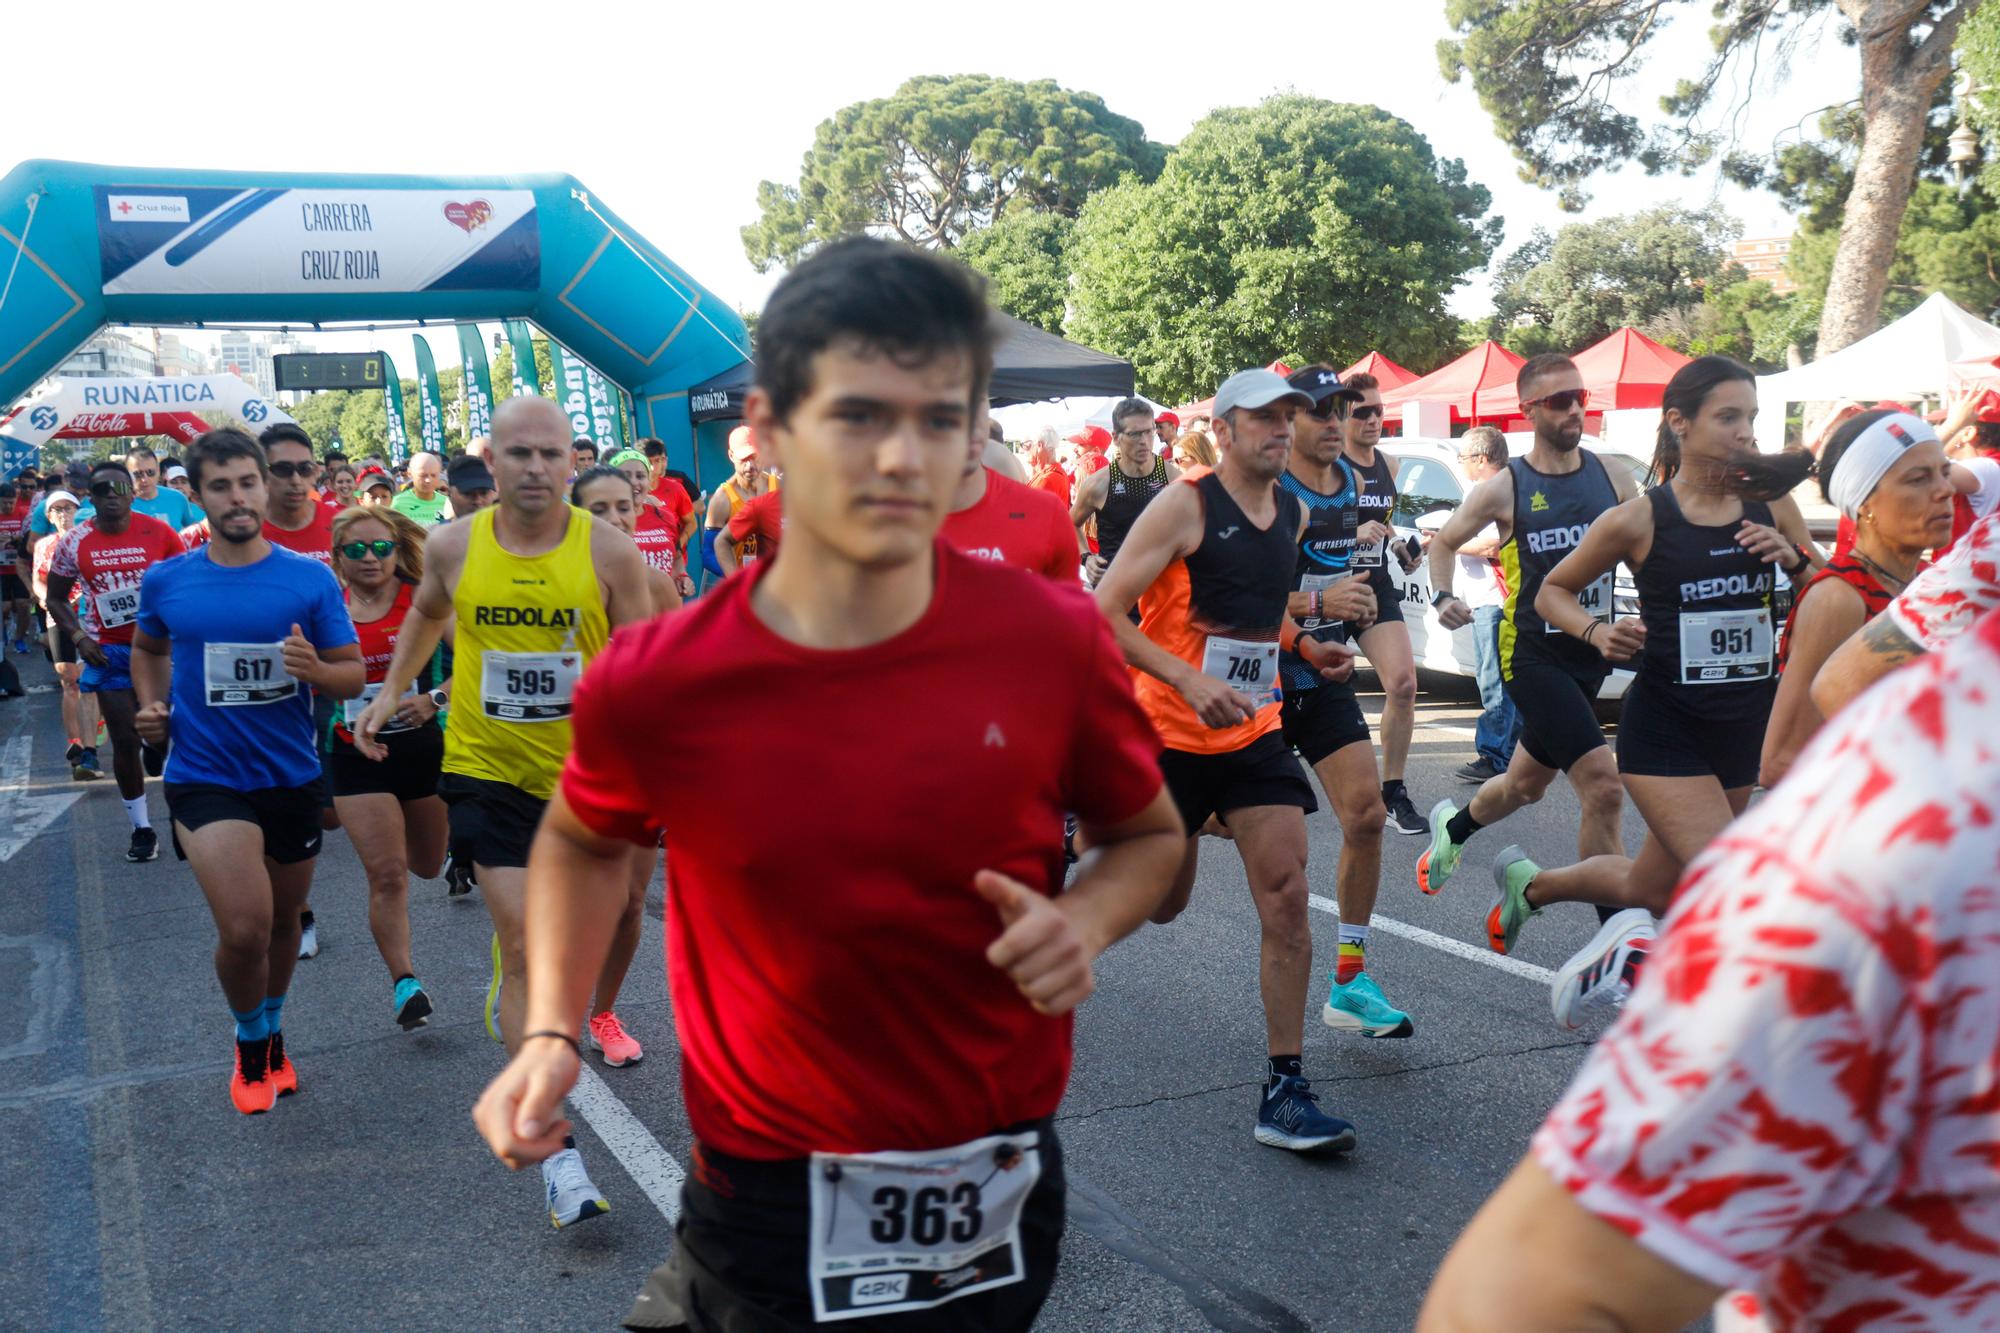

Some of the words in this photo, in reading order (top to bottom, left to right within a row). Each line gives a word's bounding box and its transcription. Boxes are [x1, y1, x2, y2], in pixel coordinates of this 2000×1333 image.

[136, 204, 158, 212] Cruz
[161, 204, 182, 213] Roja
[302, 203, 372, 232] CARRERA
[301, 251, 341, 280] CRUZ
[344, 250, 381, 280] ROJA
[84, 381, 214, 406] RUNÁTICA
[1359, 495, 1393, 508] EDOLAT
[93, 557, 120, 567] CRUZ
[120, 556, 147, 565] ROJA
[101, 547, 146, 558] CARRERA
[109, 595, 137, 613] 593
[1711, 628, 1753, 655] 951
[234, 658, 272, 682] 617
[1227, 656, 1261, 683] 748
[507, 669, 556, 695] 595
[870, 1181, 983, 1246] 363
[856, 1279, 903, 1297] 42K
